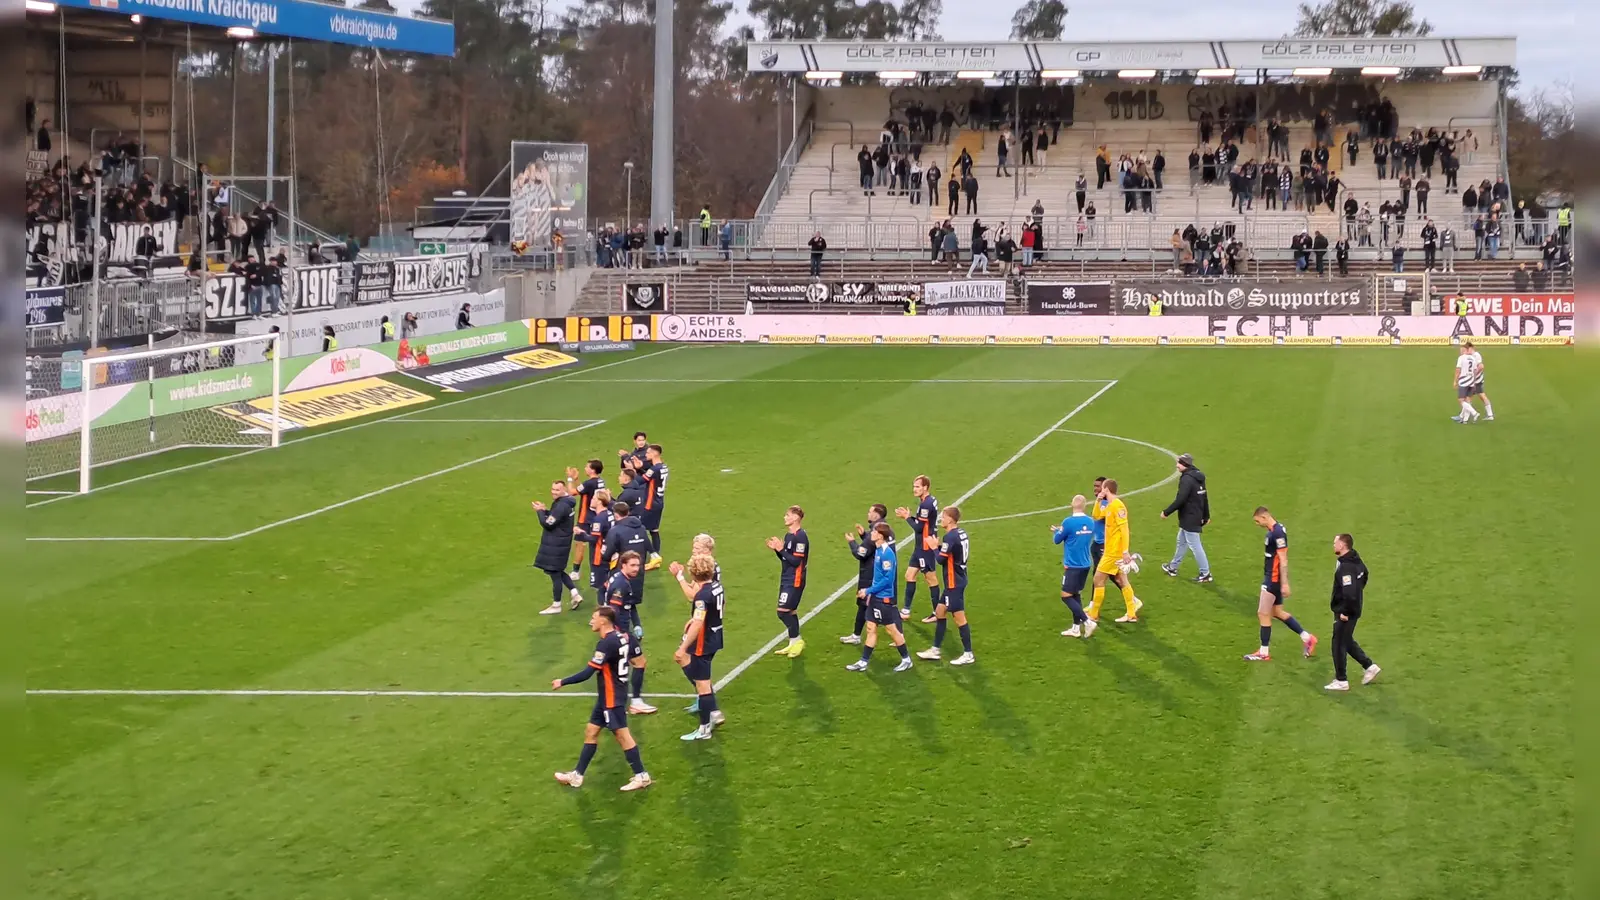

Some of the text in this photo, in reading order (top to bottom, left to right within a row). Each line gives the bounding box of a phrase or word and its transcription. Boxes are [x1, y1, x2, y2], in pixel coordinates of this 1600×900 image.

[127, 0, 277, 27] sbank Kraichgau
[330, 14, 398, 41] vbkraichgau.de
[846, 44, 895, 58] GÖLZ
[1261, 41, 1312, 55] GÖLZ
[394, 262, 428, 292] HEJA
[300, 267, 339, 307] 1916
[843, 282, 864, 296] SV
[878, 284, 921, 292] THREE POINTS
[949, 284, 1002, 299] LIGAZWERG
[1247, 287, 1361, 311] Supporters
[1449, 297, 1503, 313] EWE
[1511, 297, 1544, 313] Dein
[954, 306, 1005, 316] SANDHAUSEN
[689, 316, 736, 326] ECHT &
[1378, 315, 1400, 337] &
[169, 372, 253, 401] www.kidsmeal.de
[617, 644, 630, 676] 2
